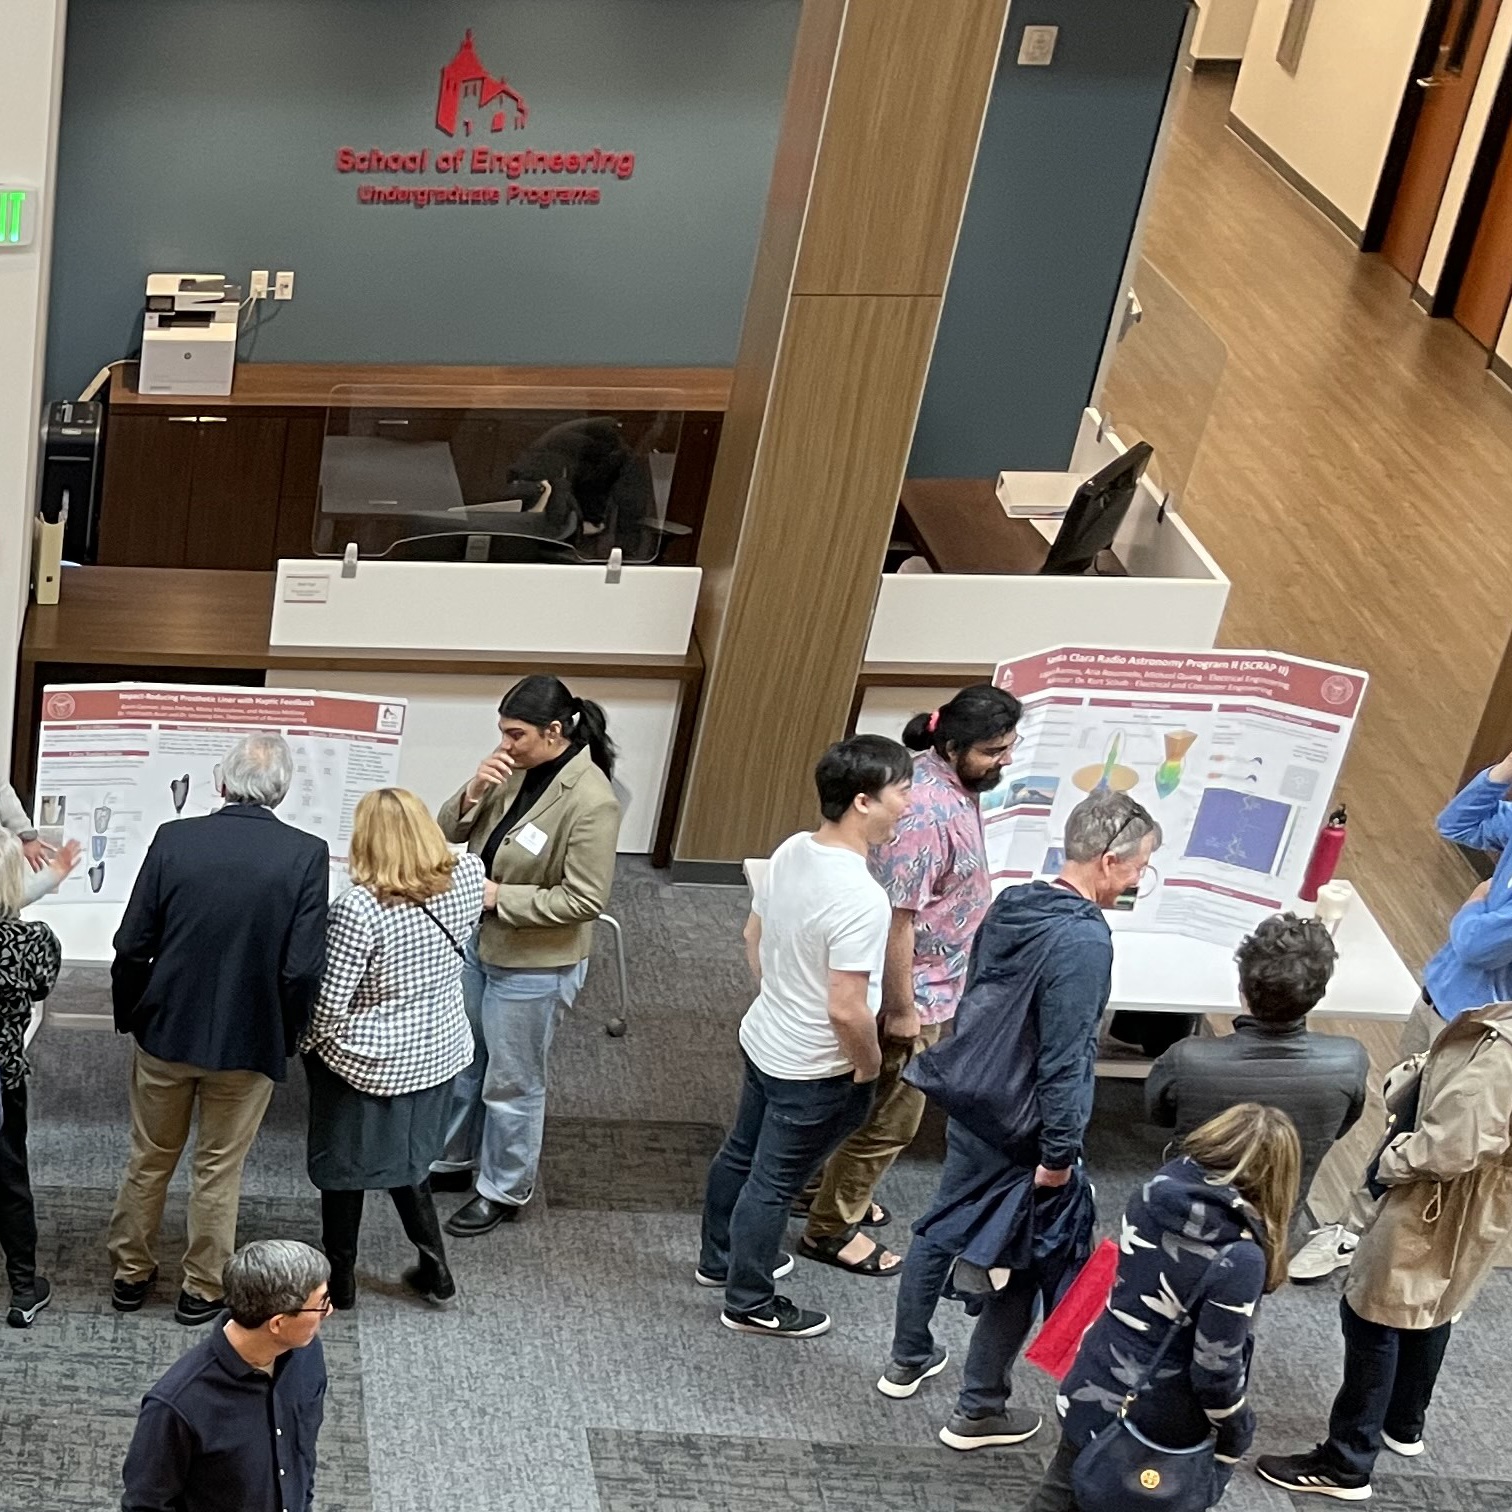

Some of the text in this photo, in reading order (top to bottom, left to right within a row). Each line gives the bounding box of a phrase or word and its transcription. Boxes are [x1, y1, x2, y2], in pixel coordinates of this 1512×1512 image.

[336, 147, 635, 179] School of Engineering
[358, 185, 601, 207] Undergraduate Programs
[1069, 653, 1095, 662] Clara
[1097, 655, 1126, 664] Radio
[1128, 656, 1184, 668] Astronomy
[1186, 659, 1229, 670] Program
[1240, 661, 1276, 671] (SCRAP
